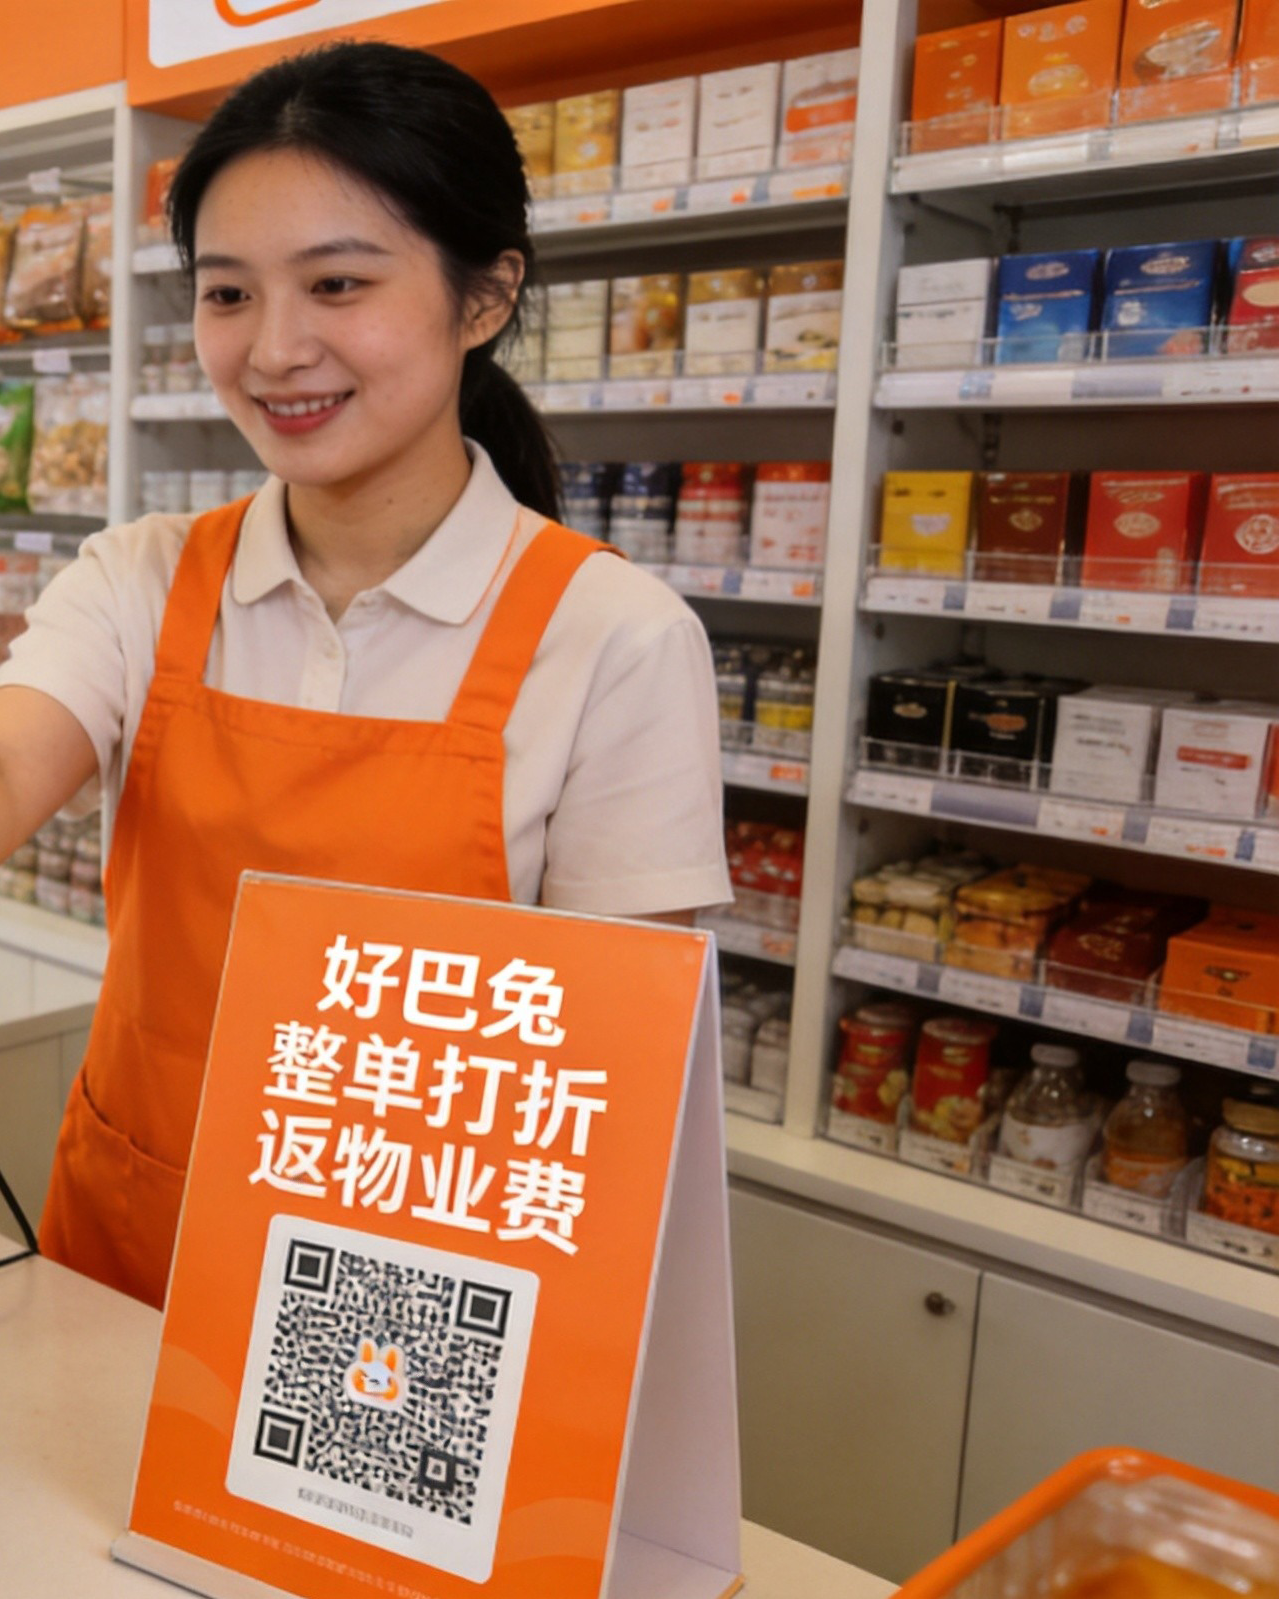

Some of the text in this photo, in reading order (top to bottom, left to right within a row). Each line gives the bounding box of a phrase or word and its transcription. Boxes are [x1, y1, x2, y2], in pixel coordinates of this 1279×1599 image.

[316, 934, 566, 1047] 好巴兔
[263, 1020, 608, 1157] 整单打折
[248, 1109, 587, 1255] 返物业费
